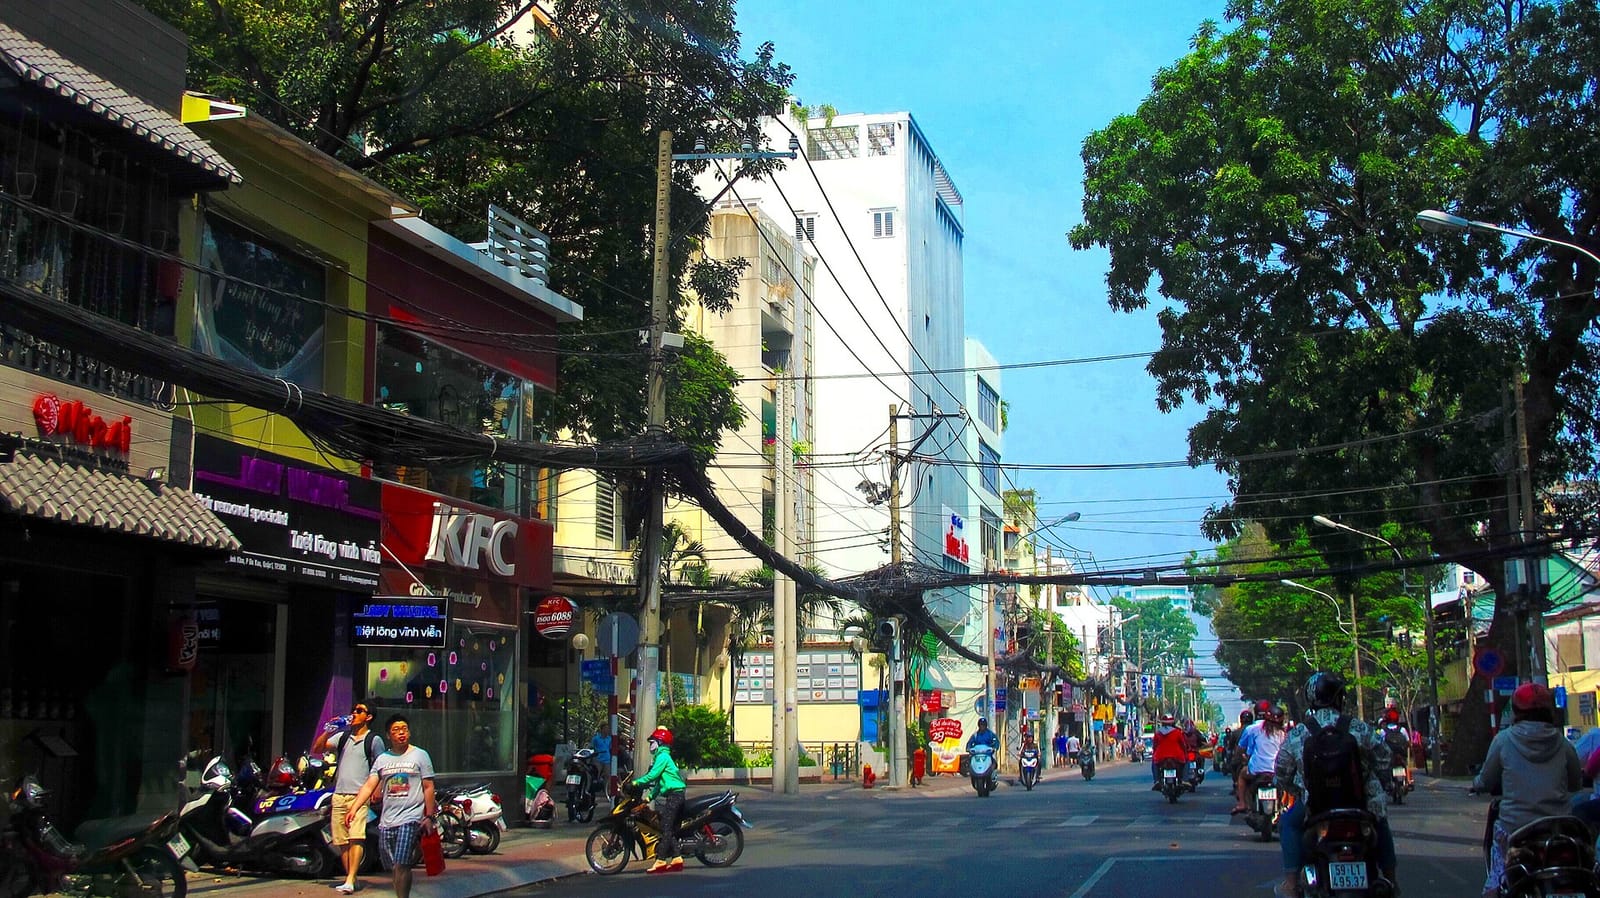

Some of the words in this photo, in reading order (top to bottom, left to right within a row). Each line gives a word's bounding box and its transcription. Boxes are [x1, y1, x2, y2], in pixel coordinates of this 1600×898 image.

[214, 500, 249, 518] removal
[250, 507, 289, 526] specialist
[314, 534, 338, 560] lông
[338, 542, 359, 560] vĩnh
[425, 502, 518, 576] KFC
[442, 587, 482, 608] Kentucky
[356, 625, 375, 638] Triệt
[376, 626, 397, 638] lông
[398, 627, 418, 637] vĩnh
[421, 624, 441, 637] viễn
[1332, 875, 1365, 887] 495.37
